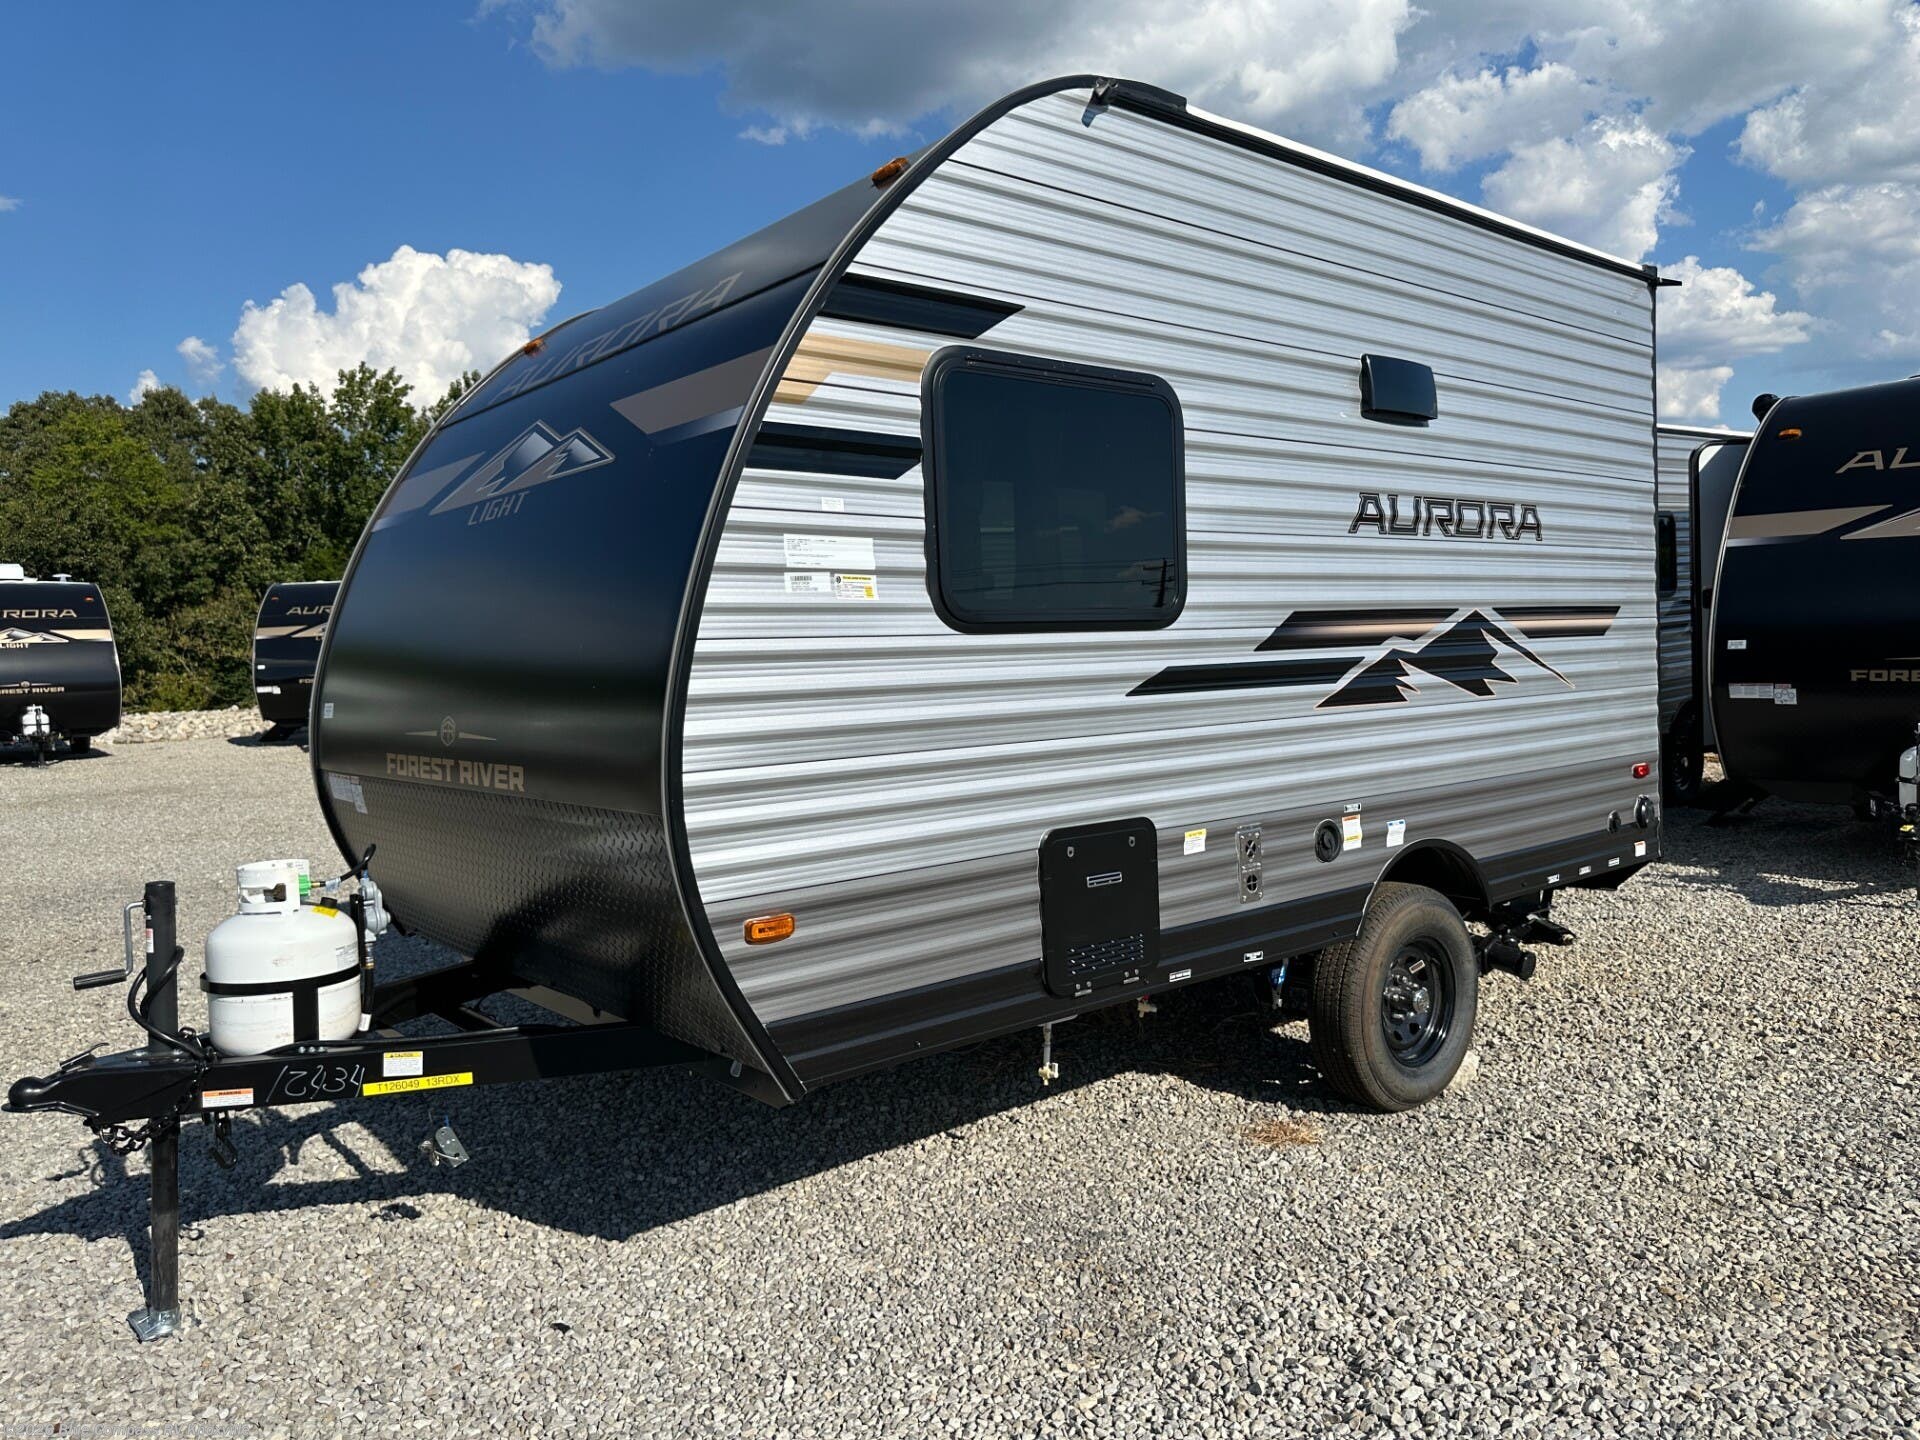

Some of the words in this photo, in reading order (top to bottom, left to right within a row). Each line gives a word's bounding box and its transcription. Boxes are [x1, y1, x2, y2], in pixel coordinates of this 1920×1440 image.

[489, 272, 742, 403] AURORA
[467, 491, 530, 526] LIGHT
[1349, 493, 1543, 541] AURORA
[3, 609, 77, 618] RORA
[286, 605, 334, 616] AUR
[1850, 669, 1920, 682] FORE
[386, 752, 454, 782] FOREST
[458, 760, 525, 792] RIVER
[377, 1079, 420, 1093] T126049
[427, 1074, 461, 1088] 13RDX
